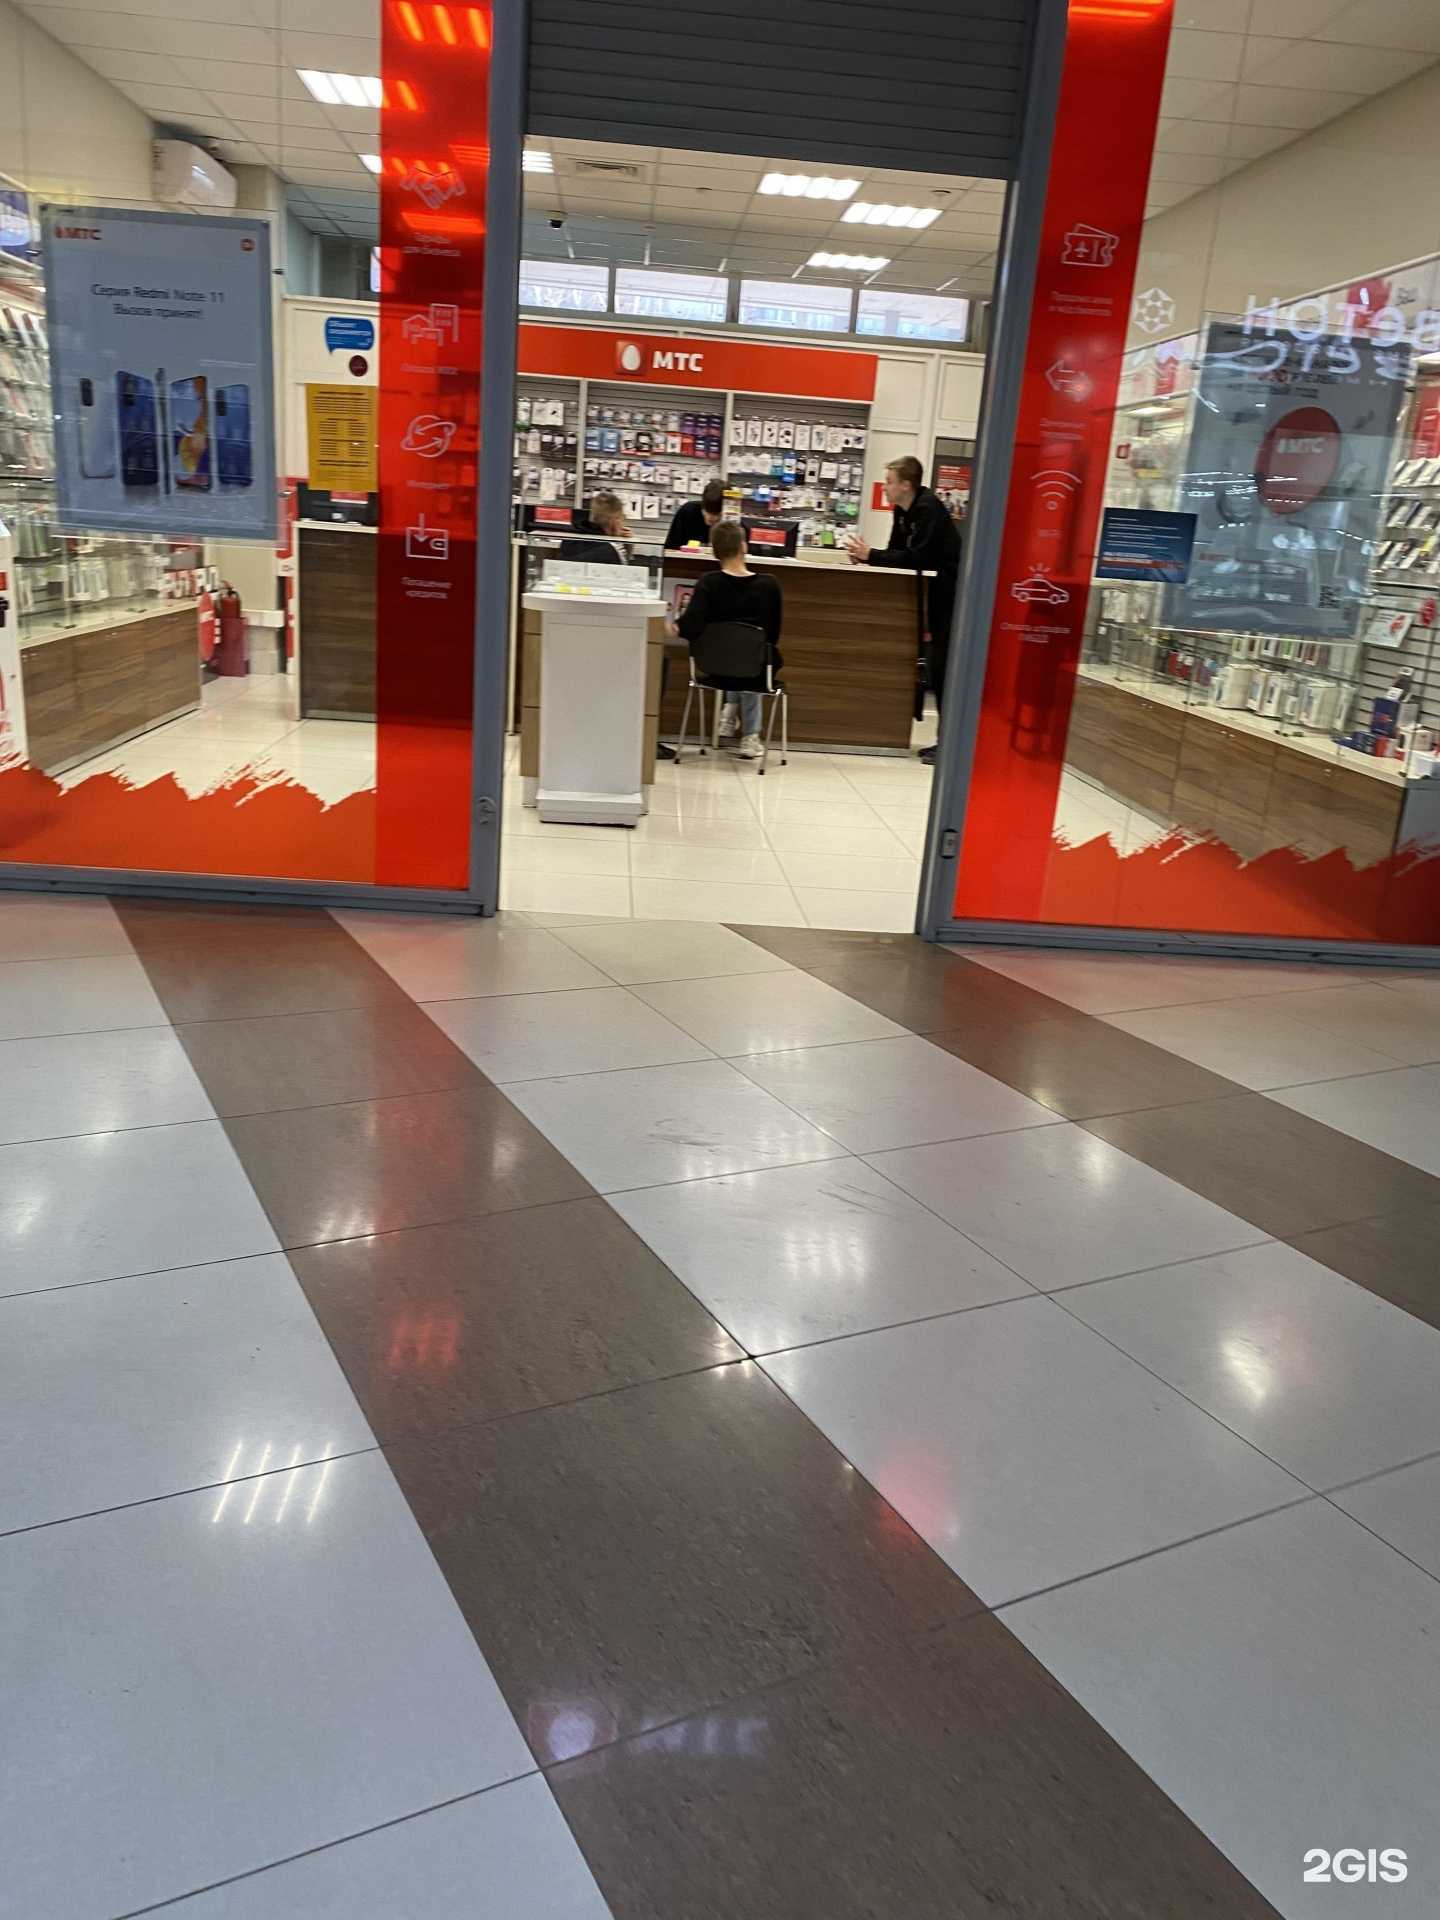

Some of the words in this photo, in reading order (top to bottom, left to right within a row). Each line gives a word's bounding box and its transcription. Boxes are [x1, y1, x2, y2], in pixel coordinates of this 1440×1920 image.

[65, 227, 102, 241] МТС
[90, 283, 131, 299] Серия
[133, 286, 169, 300] Redmi
[174, 288, 206, 302] Note
[210, 291, 225, 303] 11
[113, 302, 152, 317] Вызов
[652, 350, 704, 373] МТС
